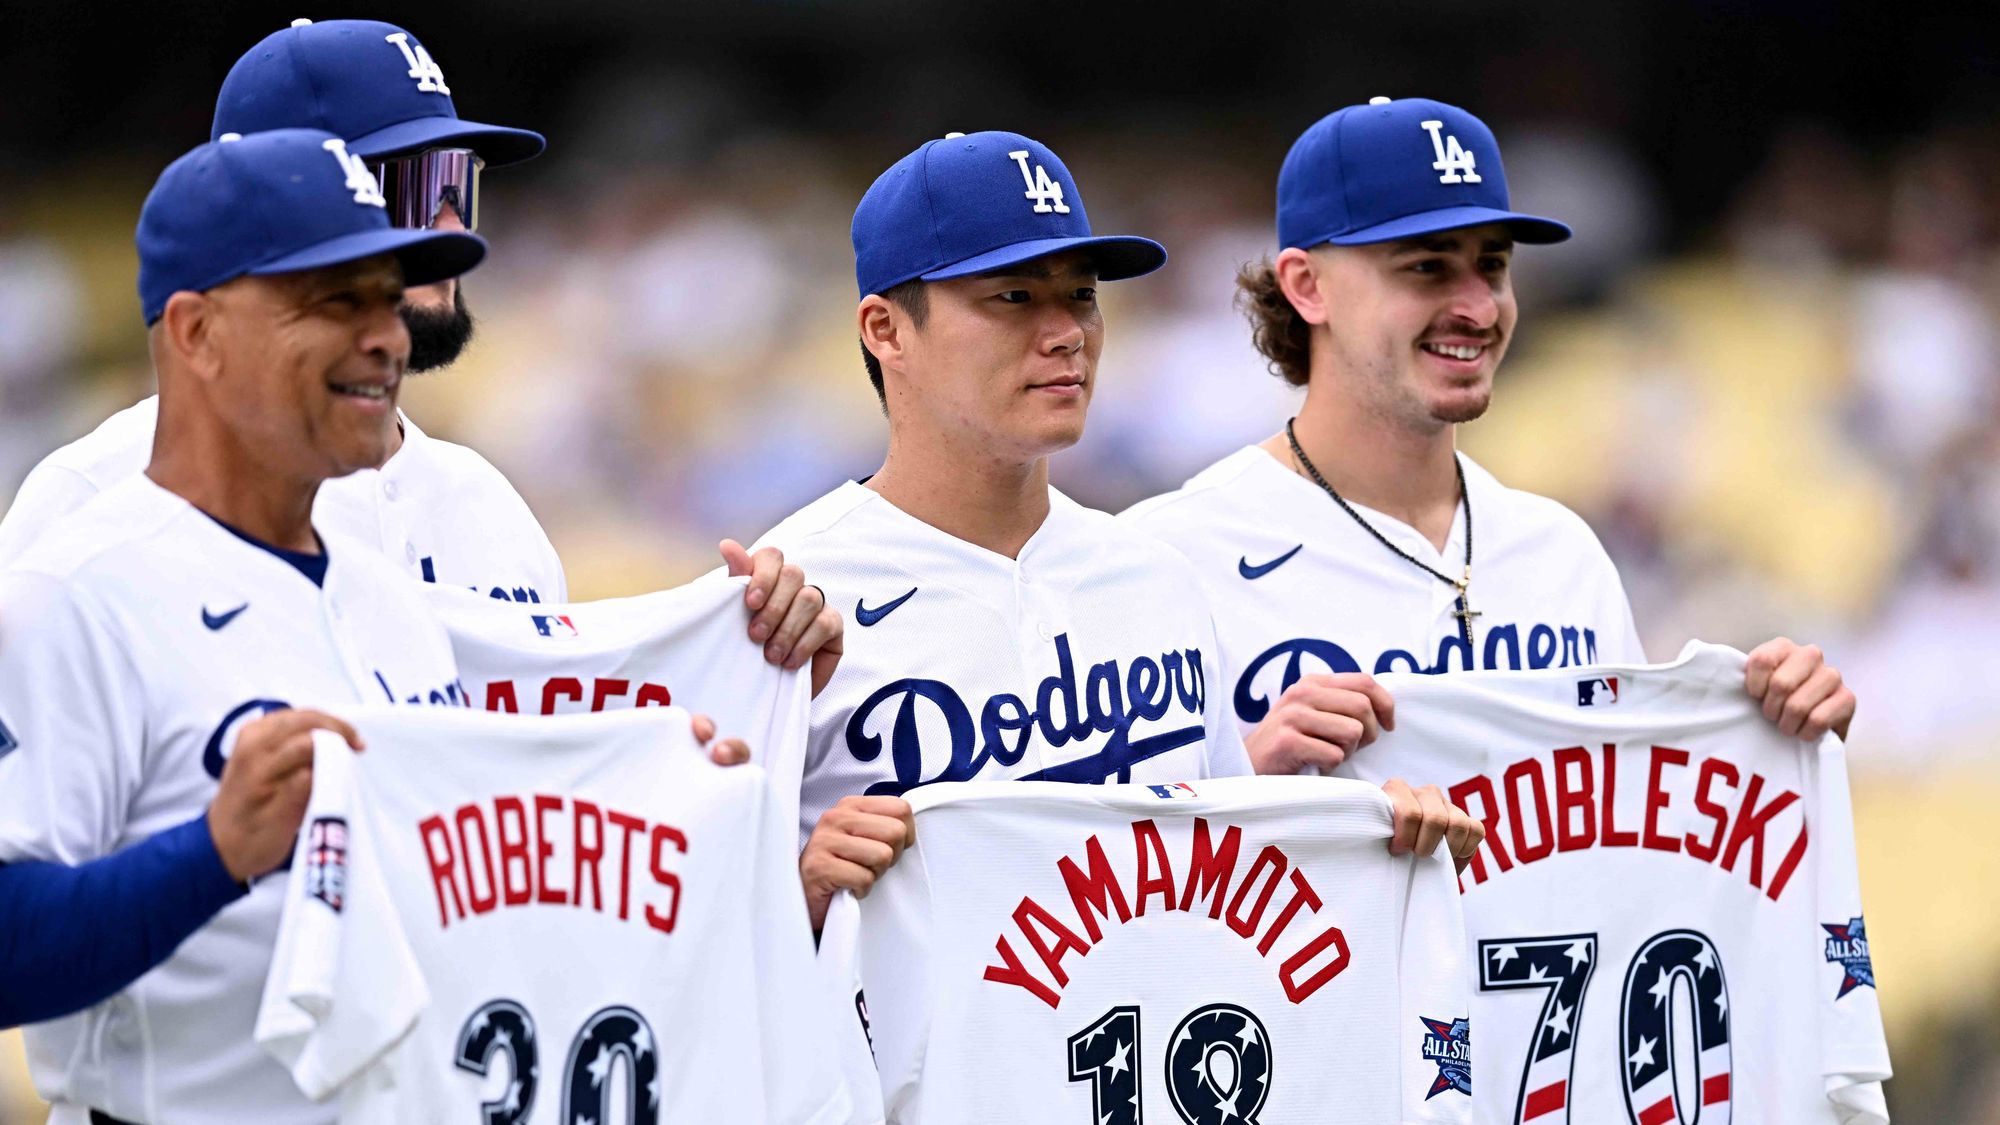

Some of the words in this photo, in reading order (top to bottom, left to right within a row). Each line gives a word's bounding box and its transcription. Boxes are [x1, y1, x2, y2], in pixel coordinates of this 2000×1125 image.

[386, 32, 451, 96] LA
[323, 138, 386, 208] LA
[1009, 150, 1070, 214] LA
[1421, 120, 1482, 184] LA
[845, 632, 1206, 797] Dodgers
[418, 793, 688, 934] ROBERTS
[1448, 743, 1809, 902] ROBLESKI
[983, 817, 1350, 1009] YAMAMOTO
[1825, 939, 1851, 959] ALL
[454, 998, 661, 1125] 30
[1067, 1003, 1273, 1125] 18
[1424, 1036, 1450, 1057] ALL
[1451, 1039, 1470, 1061] STA
[1478, 929, 1733, 1125] 70
